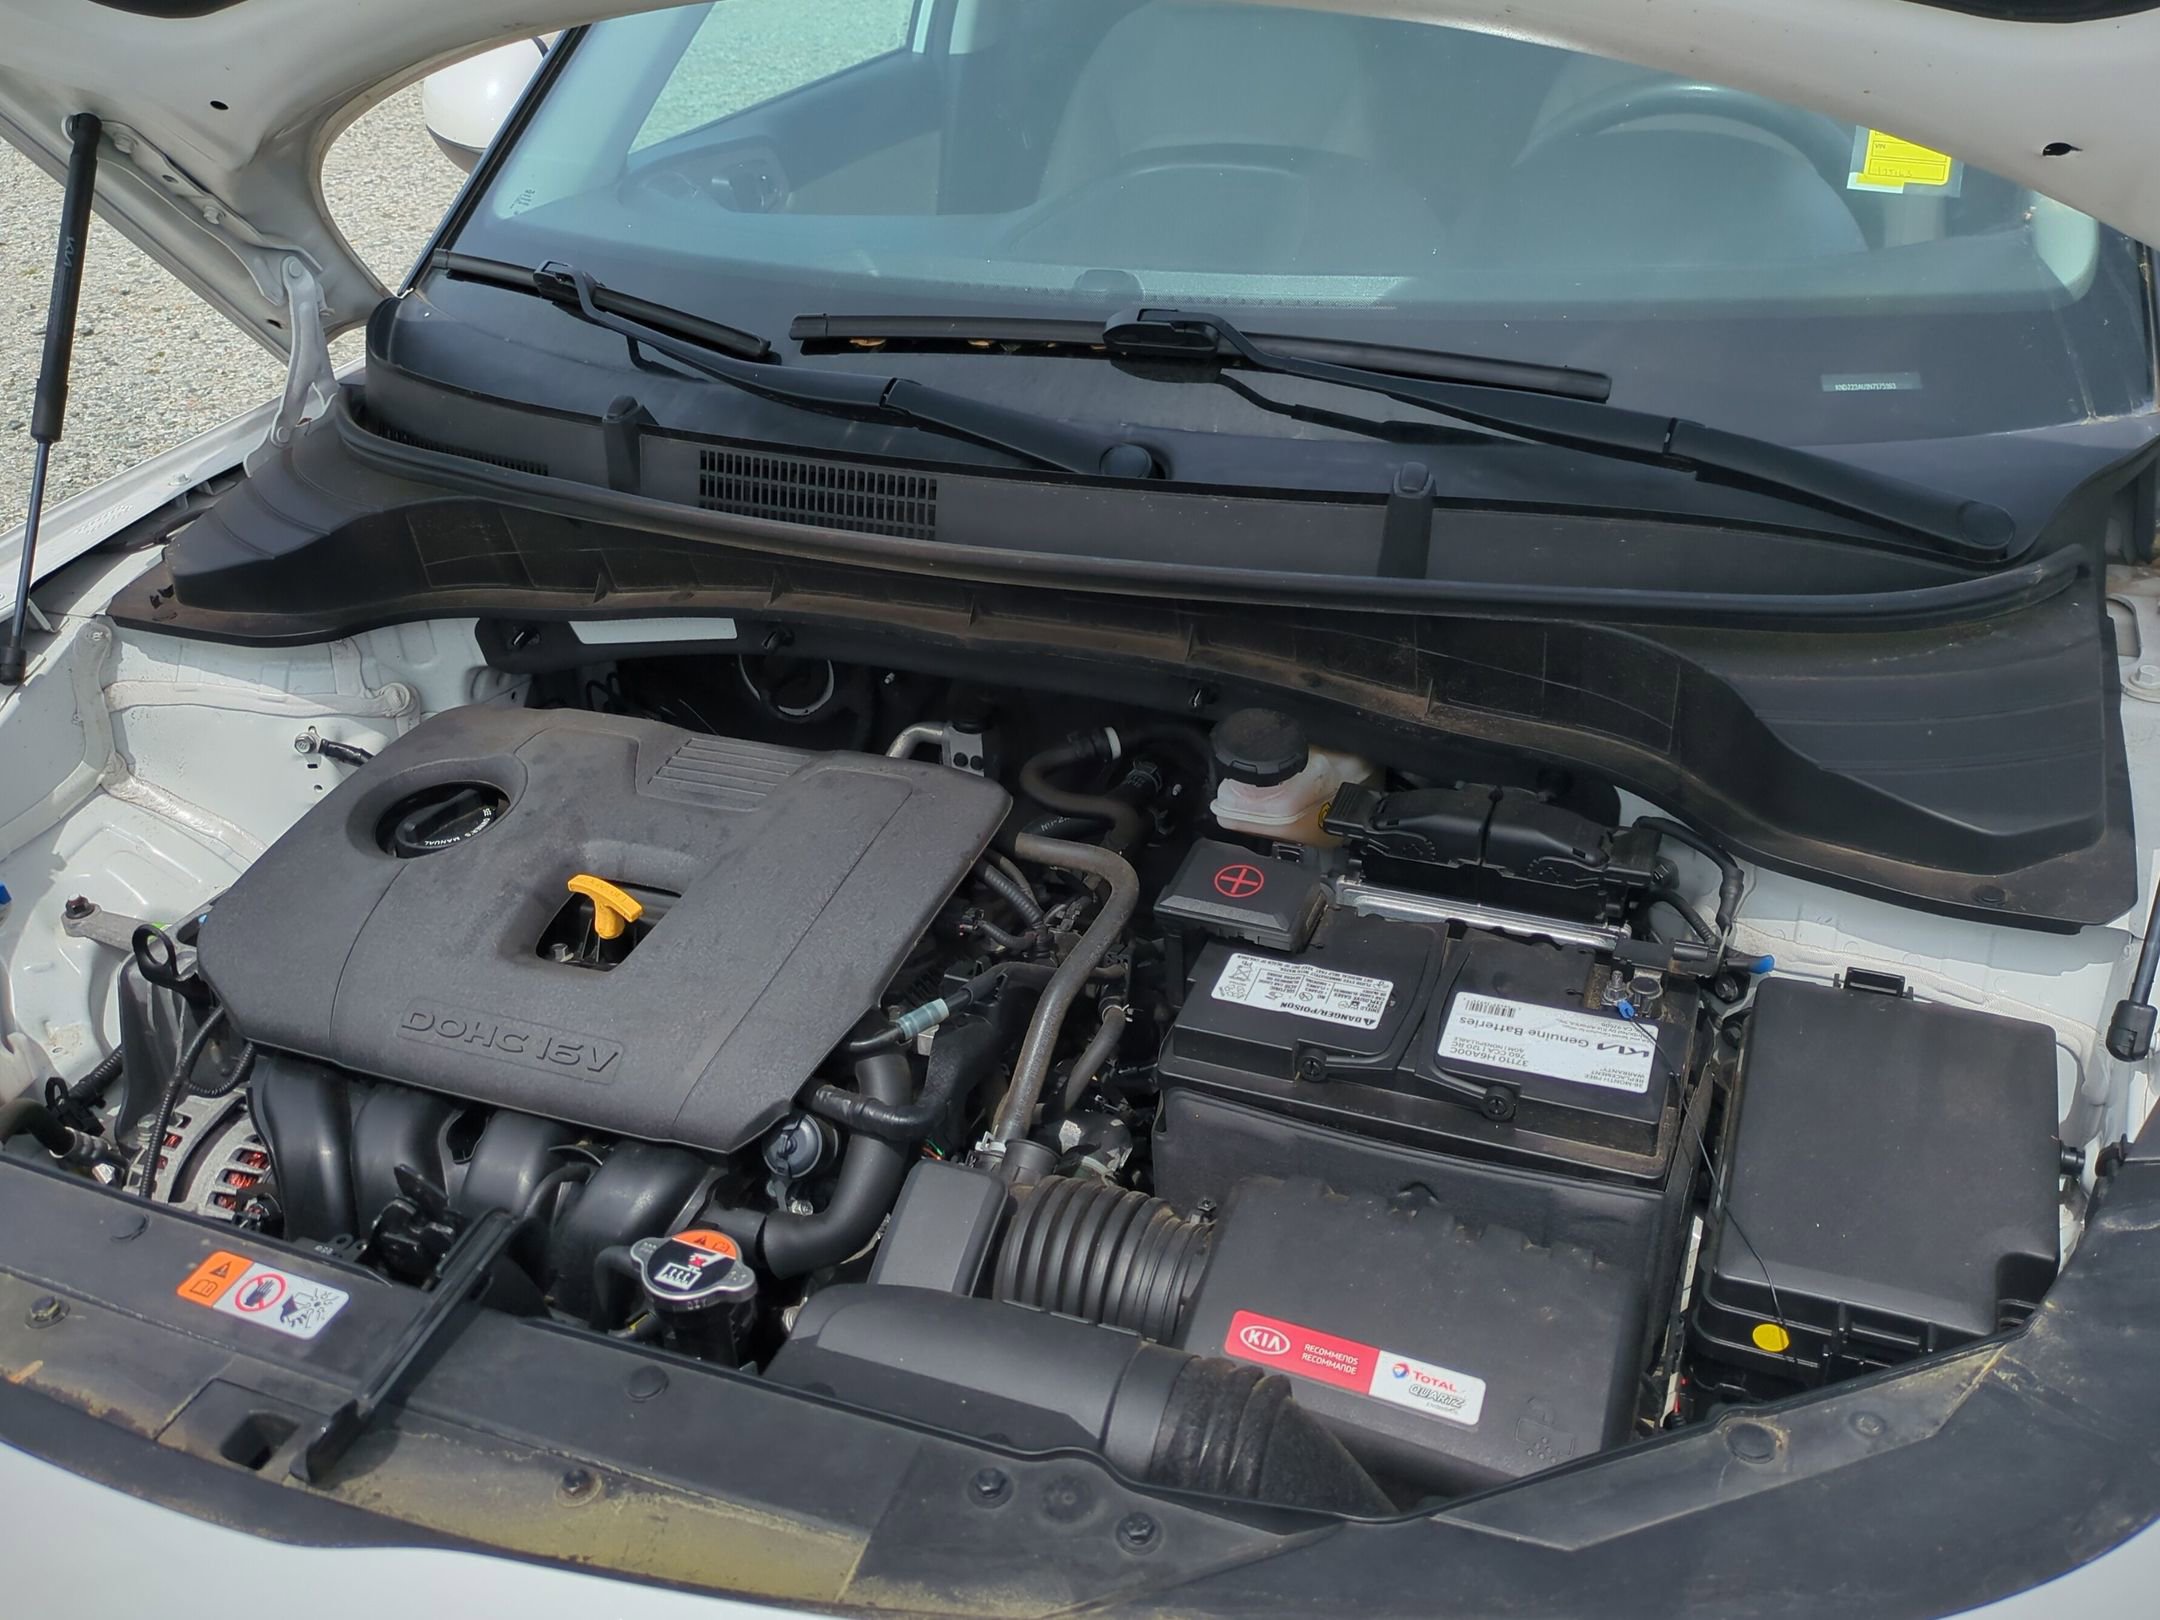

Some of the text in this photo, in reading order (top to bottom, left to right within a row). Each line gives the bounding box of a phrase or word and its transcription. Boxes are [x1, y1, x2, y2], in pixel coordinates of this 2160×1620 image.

[424, 836, 460, 847] MANUAL
[1280, 1002, 1362, 1023] DANGER/POISON
[401, 1012, 620, 1073] DOHC 16V
[1458, 1017, 1590, 1048] Genuine Batteries
[1488, 1048, 1507, 1056] CCA
[1508, 1051, 1526, 1059] 760
[1597, 1042, 1650, 1059] KIA
[1498, 1056, 1529, 1067] 37110
[1591, 1070, 1644, 1084] REPLACEMENT
[1247, 1328, 1282, 1352] KIA
[1302, 1352, 1358, 1375] RECOMMANDE
[1304, 1343, 1359, 1366] RECOMMENDS
[1412, 1370, 1457, 1392] TOTAL
[1408, 1384, 1466, 1409] QUARTZ
